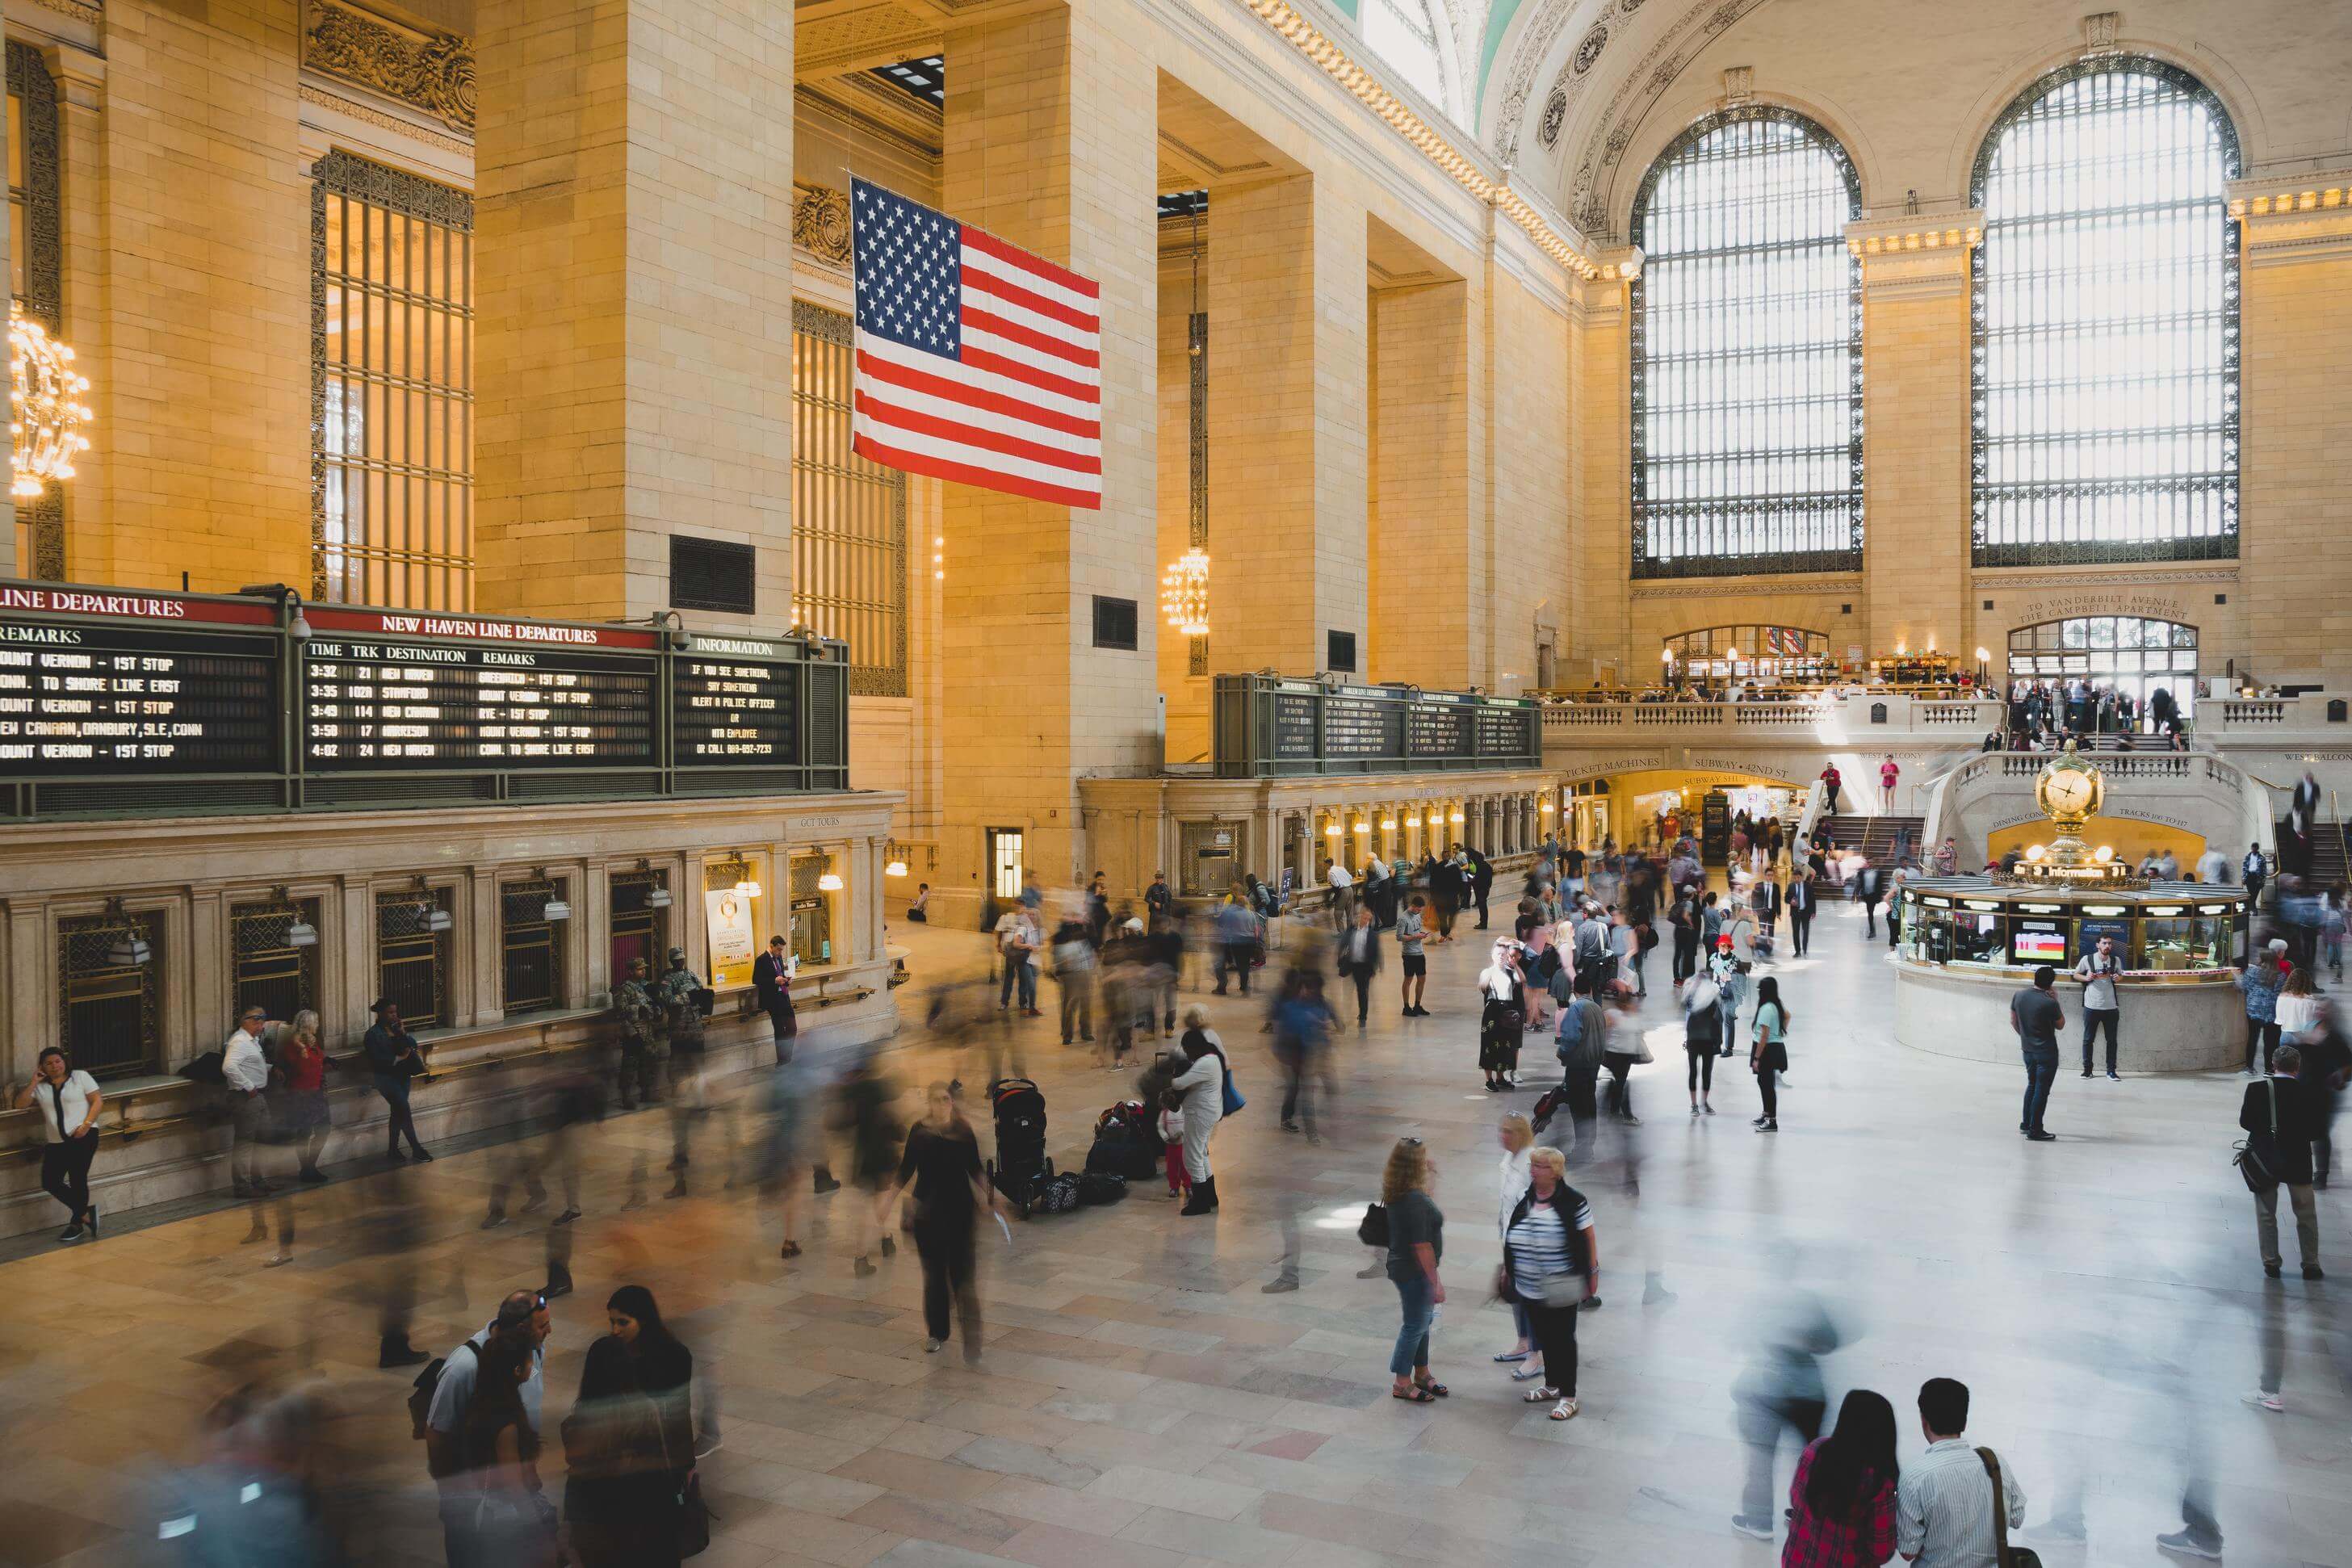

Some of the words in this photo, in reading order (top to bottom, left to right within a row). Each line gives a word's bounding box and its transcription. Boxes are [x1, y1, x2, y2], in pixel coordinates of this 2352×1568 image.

[0, 589, 45, 609] INE
[52, 592, 184, 618] DEPARTURES
[2027, 603, 2043, 612] TO
[2049, 596, 2124, 607] VANDERBILT
[2131, 596, 2178, 609] AVENUE
[2019, 613, 2042, 623] THE
[2048, 605, 2108, 617] CAMPBELL
[2117, 605, 2188, 620] APARTMENT
[0, 627, 82, 644] REMARKS
[382, 615, 421, 632] NEW
[425, 618, 476, 636] HAVEN
[480, 622, 513, 639] LINE
[515, 625, 597, 644] DEPARTURES
[696, 637, 774, 656] INFORMATION
[309, 644, 342, 656] TIME
[352, 645, 379, 658] TRK
[386, 647, 467, 663] DESTINATION
[483, 652, 535, 666] REMARKS
[0, 652, 34, 666] OUNT
[40, 653, 90, 669] VERNON
[114, 656, 137, 671] 1ST
[142, 658, 174, 672] STOP
[358, 666, 371, 679] 21
[692, 665, 701, 674] IF
[704, 665, 716, 675] YOU
[719, 666, 732, 676] SEE
[0, 675, 31, 689] ONN.
[41, 677, 59, 690] TO
[65, 677, 107, 692] SHORE
[113, 679, 145, 692] LINE
[150, 680, 181, 693] EAST
[539, 673, 553, 685] 1ST
[556, 674, 577, 686] STOP
[310, 685, 337, 698] 3:35
[707, 681, 720, 691] SAY
[723, 681, 757, 693] SOMETHING
[553, 692, 568, 703] 1ST
[570, 693, 590, 704] STOP
[692, 697, 713, 706] ALERT
[715, 697, 720, 706] A
[723, 698, 747, 707] POLICE
[748, 698, 775, 709] OFFICER
[0, 698, 35, 712] OUNT
[41, 699, 91, 713] VERNON
[114, 701, 137, 714] 1ST
[143, 702, 174, 715] STOP
[354, 706, 373, 718] 114
[509, 708, 526, 719] 1ST
[529, 709, 550, 720] STOP
[730, 713, 740, 723] OR
[2, 721, 19, 735] EW
[360, 725, 373, 737] 17
[553, 726, 568, 737] 1ST
[571, 726, 591, 738] STOP
[727, 728, 757, 739] EMPLOYEE
[0, 744, 35, 759] OUNT
[41, 744, 92, 758] VERNON
[115, 744, 138, 758] 1ST
[143, 744, 174, 758] STOP
[359, 744, 374, 757] 24
[509, 744, 522, 756] TO
[552, 744, 573, 756] LINE
[576, 744, 595, 756] EAST
[697, 744, 706, 753] OR
[708, 744, 724, 753] CALL
[1565, 763, 1602, 779] TICKET
[1604, 758, 1660, 771] MACHINES
[1695, 758, 1738, 769] SUBWAY
[1745, 763, 1774, 776] 42ND
[1776, 769, 1789, 779] ST
[1684, 775, 1722, 786] SUBWAY
[800, 818, 816, 828] GCT
[817, 817, 840, 827] TOURS
[1993, 814, 2023, 828] DINING
[2119, 808, 2151, 819] TRACKS
[2165, 815, 2175, 824] TO
[2048, 866, 2104, 878] Information
